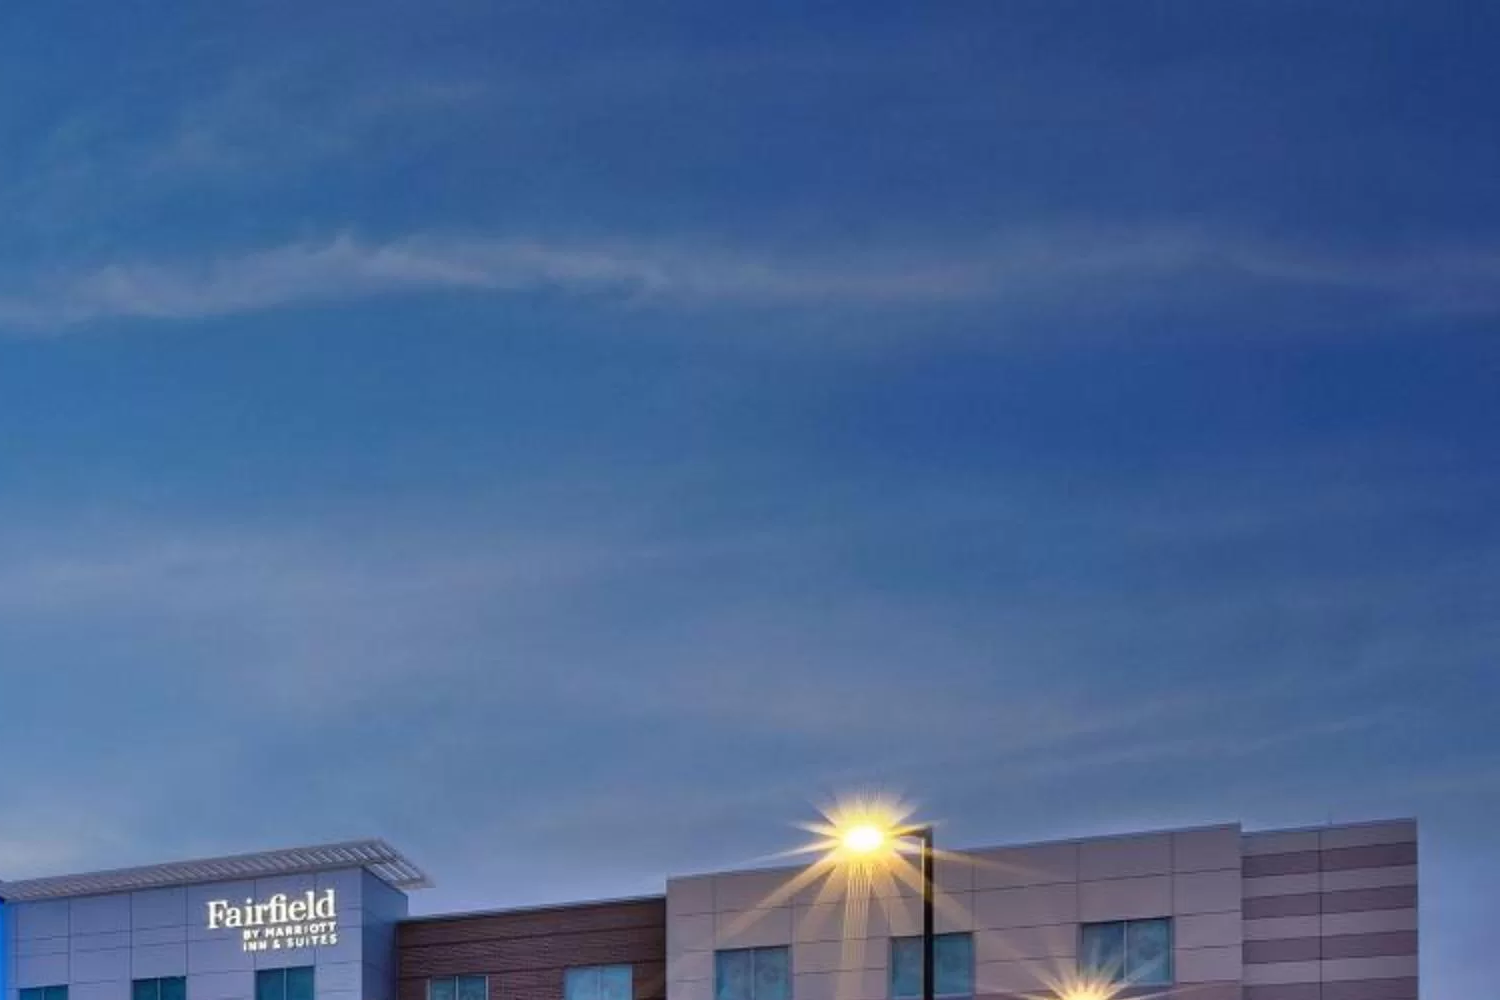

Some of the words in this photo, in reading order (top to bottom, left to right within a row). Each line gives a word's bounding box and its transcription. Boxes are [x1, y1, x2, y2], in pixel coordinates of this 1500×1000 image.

[207, 888, 337, 929] Fairfield
[243, 929, 260, 941] BY
[265, 921, 337, 938] MARRIOTT
[243, 939, 267, 952] INN
[272, 938, 281, 949] &
[287, 933, 338, 949] SUITES
